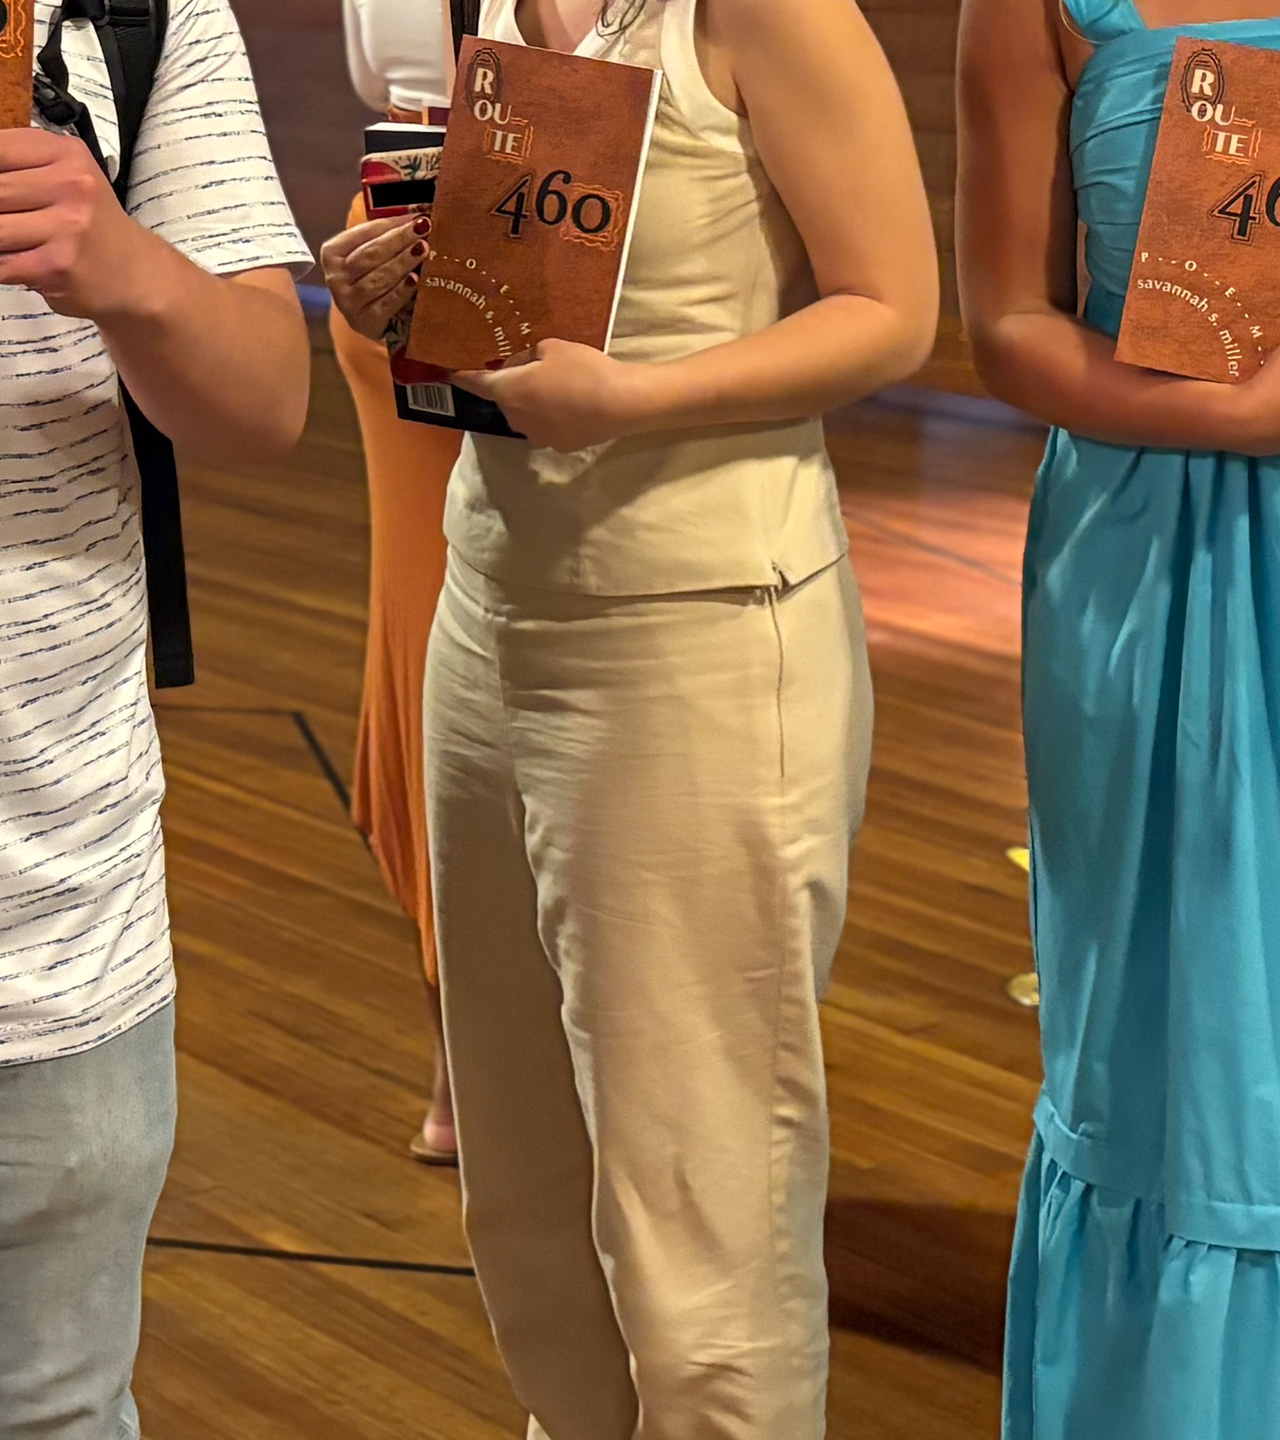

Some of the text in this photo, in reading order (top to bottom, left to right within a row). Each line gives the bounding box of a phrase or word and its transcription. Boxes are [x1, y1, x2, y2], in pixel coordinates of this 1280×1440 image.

[494, 169, 612, 237] 460
[425, 277, 487, 310] savannah
[493, 326, 513, 357] mill
[1137, 278, 1243, 378] savannah s. miller
